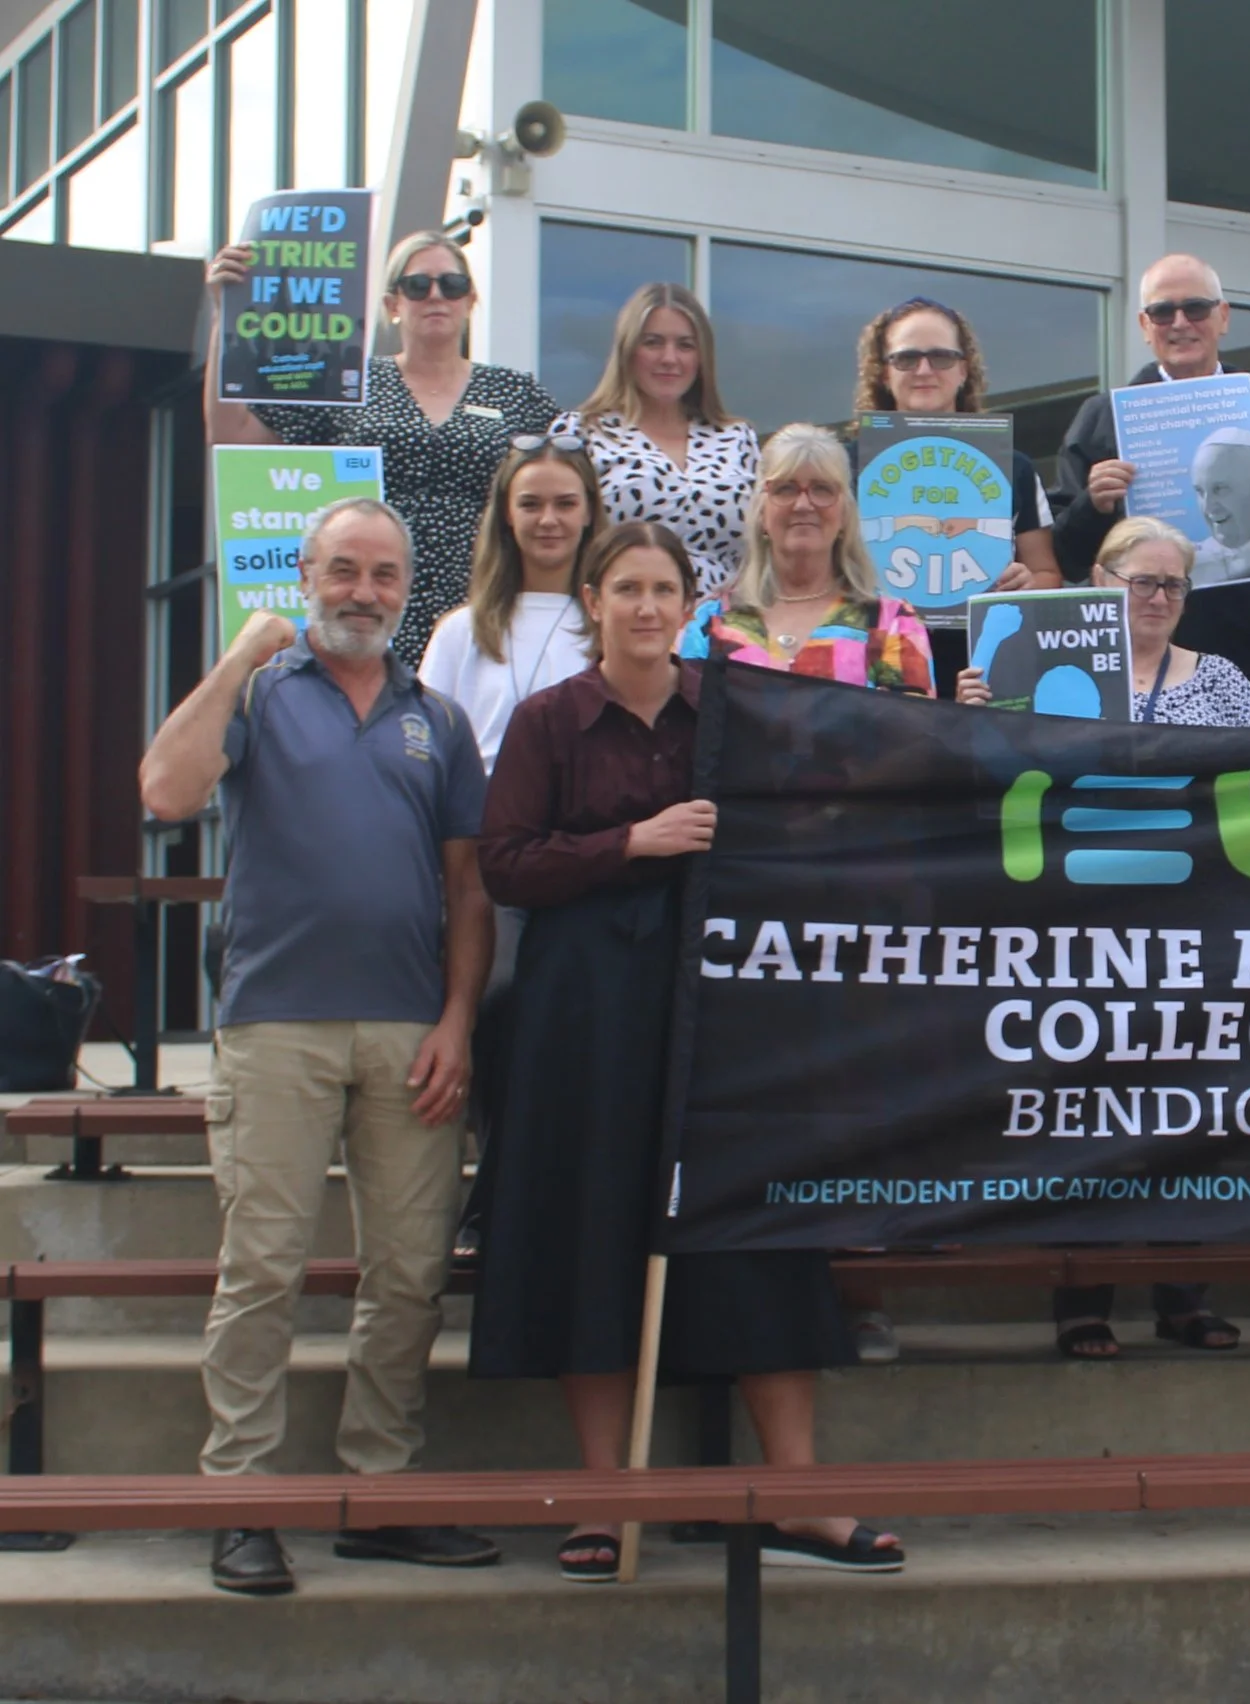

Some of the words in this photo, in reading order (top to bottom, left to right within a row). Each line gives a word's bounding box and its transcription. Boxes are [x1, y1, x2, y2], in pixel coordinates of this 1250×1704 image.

[261, 206, 346, 233] WE'D
[245, 240, 357, 269] STRIKE
[252, 276, 279, 304] IF
[288, 277, 341, 304] WE
[236, 312, 353, 341] COULD
[1121, 399, 1153, 410] Trade
[1155, 393, 1193, 405] unions
[1195, 389, 1222, 399] have
[1223, 386, 1249, 396] been
[1123, 413, 1138, 422] an
[1140, 406, 1190, 420] essential
[1192, 401, 1220, 413] force
[1222, 400, 1237, 409] for
[1125, 423, 1159, 435] social
[1207, 410, 1249, 424] without
[346, 458, 370, 468] IEU
[868, 446, 1002, 504] TOGETHER
[268, 468, 322, 491] We
[912, 486, 959, 504] FOR
[233, 548, 300, 571] solid
[885, 546, 991, 595] SIA
[237, 584, 309, 609] with
[1080, 603, 1119, 623] WE
[1036, 628, 1120, 650] WON'T
[1092, 653, 1121, 672] BE
[700, 917, 1204, 989] CATHERINE
[765, 1179, 975, 1204] INDEPENDENT
[983, 1176, 1152, 1201] EDUCATION
